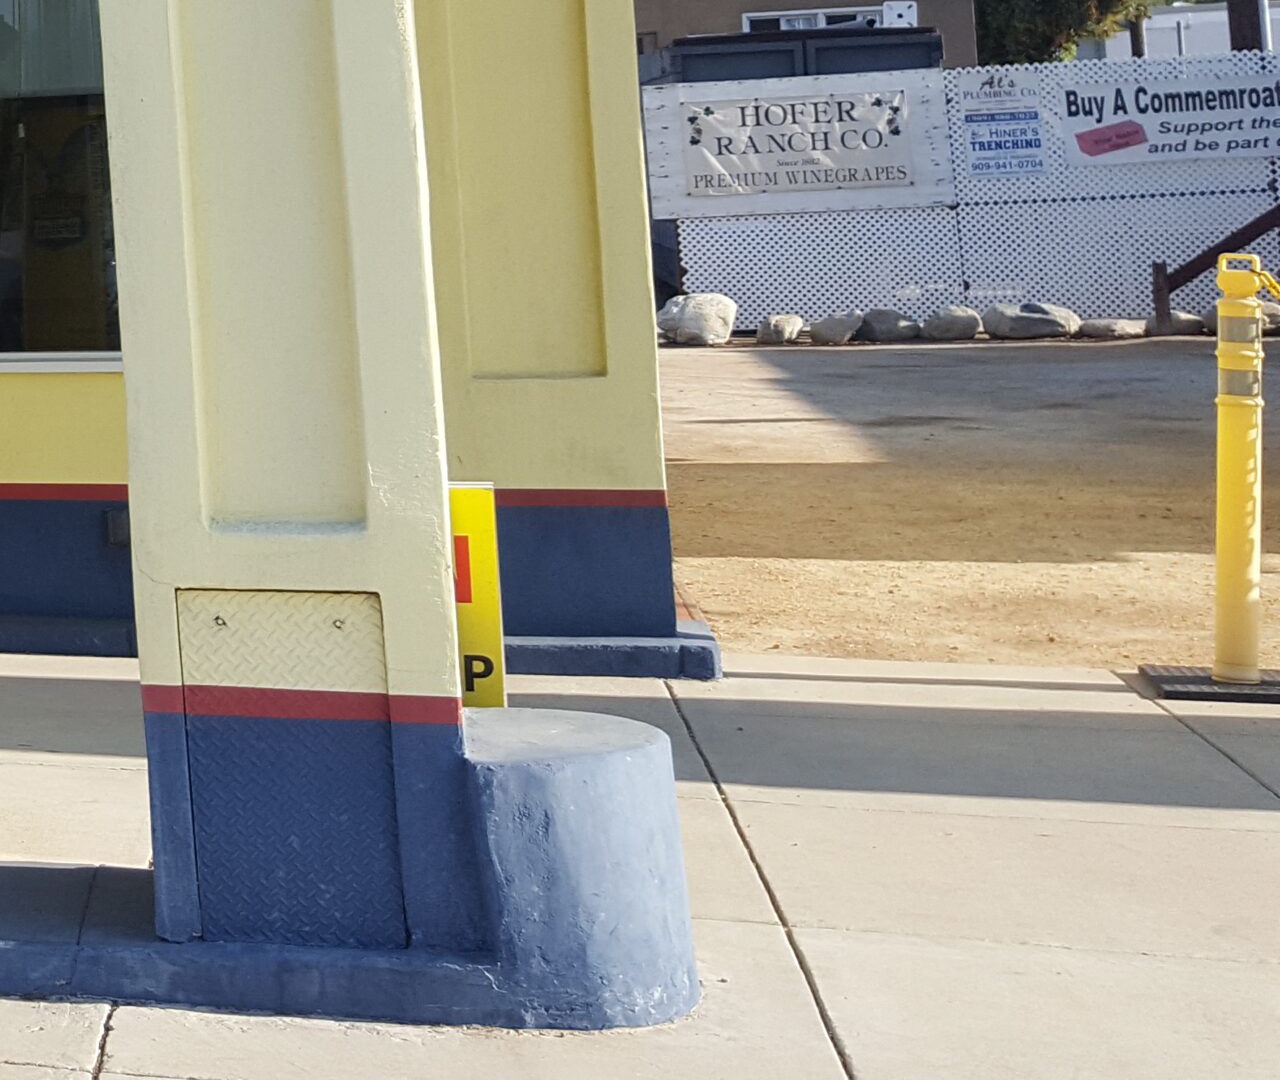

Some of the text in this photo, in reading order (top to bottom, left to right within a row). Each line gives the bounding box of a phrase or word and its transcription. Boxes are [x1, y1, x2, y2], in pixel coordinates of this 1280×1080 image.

[980, 74, 1016, 90] Al's
[738, 100, 858, 127] HOFER
[1065, 90, 1105, 123] Buy
[1113, 88, 1128, 116] A
[990, 126, 1039, 138] HINER'S
[1158, 119, 1243, 136] Support
[715, 128, 888, 155] RANCH CO.
[1148, 139, 1187, 153] and
[1194, 137, 1219, 151] be
[1226, 136, 1269, 153] part
[971, 160, 1044, 171] 909-941-0704
[694, 165, 907, 188] PREMIUM WINEGRAPES
